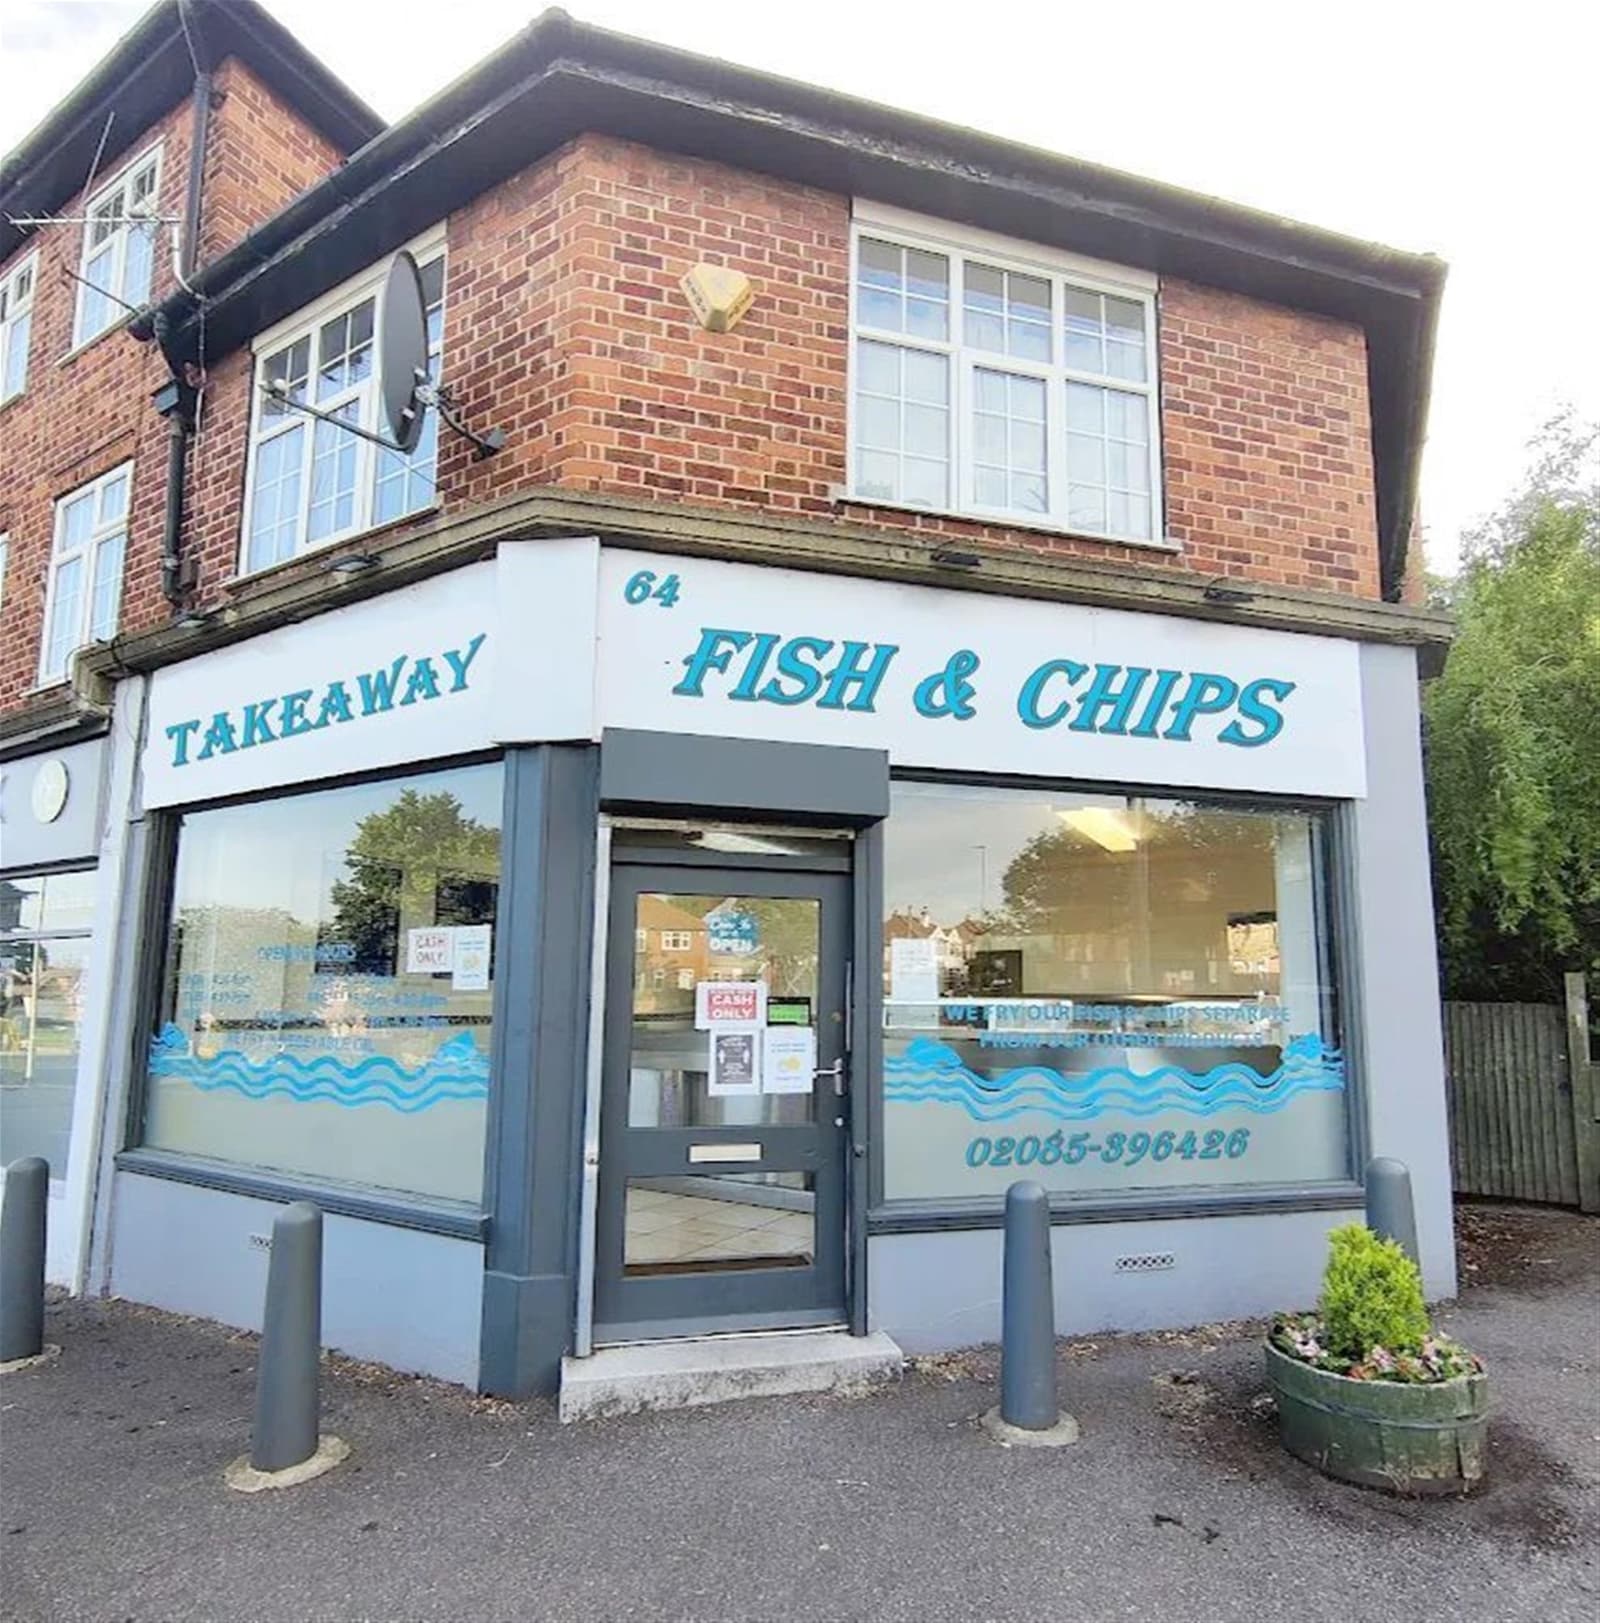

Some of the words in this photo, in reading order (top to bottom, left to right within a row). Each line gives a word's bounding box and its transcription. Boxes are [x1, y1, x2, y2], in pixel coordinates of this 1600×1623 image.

[625, 570, 680, 608] 64
[165, 634, 487, 767] TAKEAWAY
[673, 627, 899, 714] FISH
[913, 649, 980, 721] &
[1017, 659, 1296, 748] CHIPS
[711, 994, 754, 1006] CASH
[711, 1007, 753, 1019] ONLY
[944, 1004, 978, 1021] WE
[983, 1004, 1022, 1021] FRY
[1027, 1004, 1071, 1021] OUR
